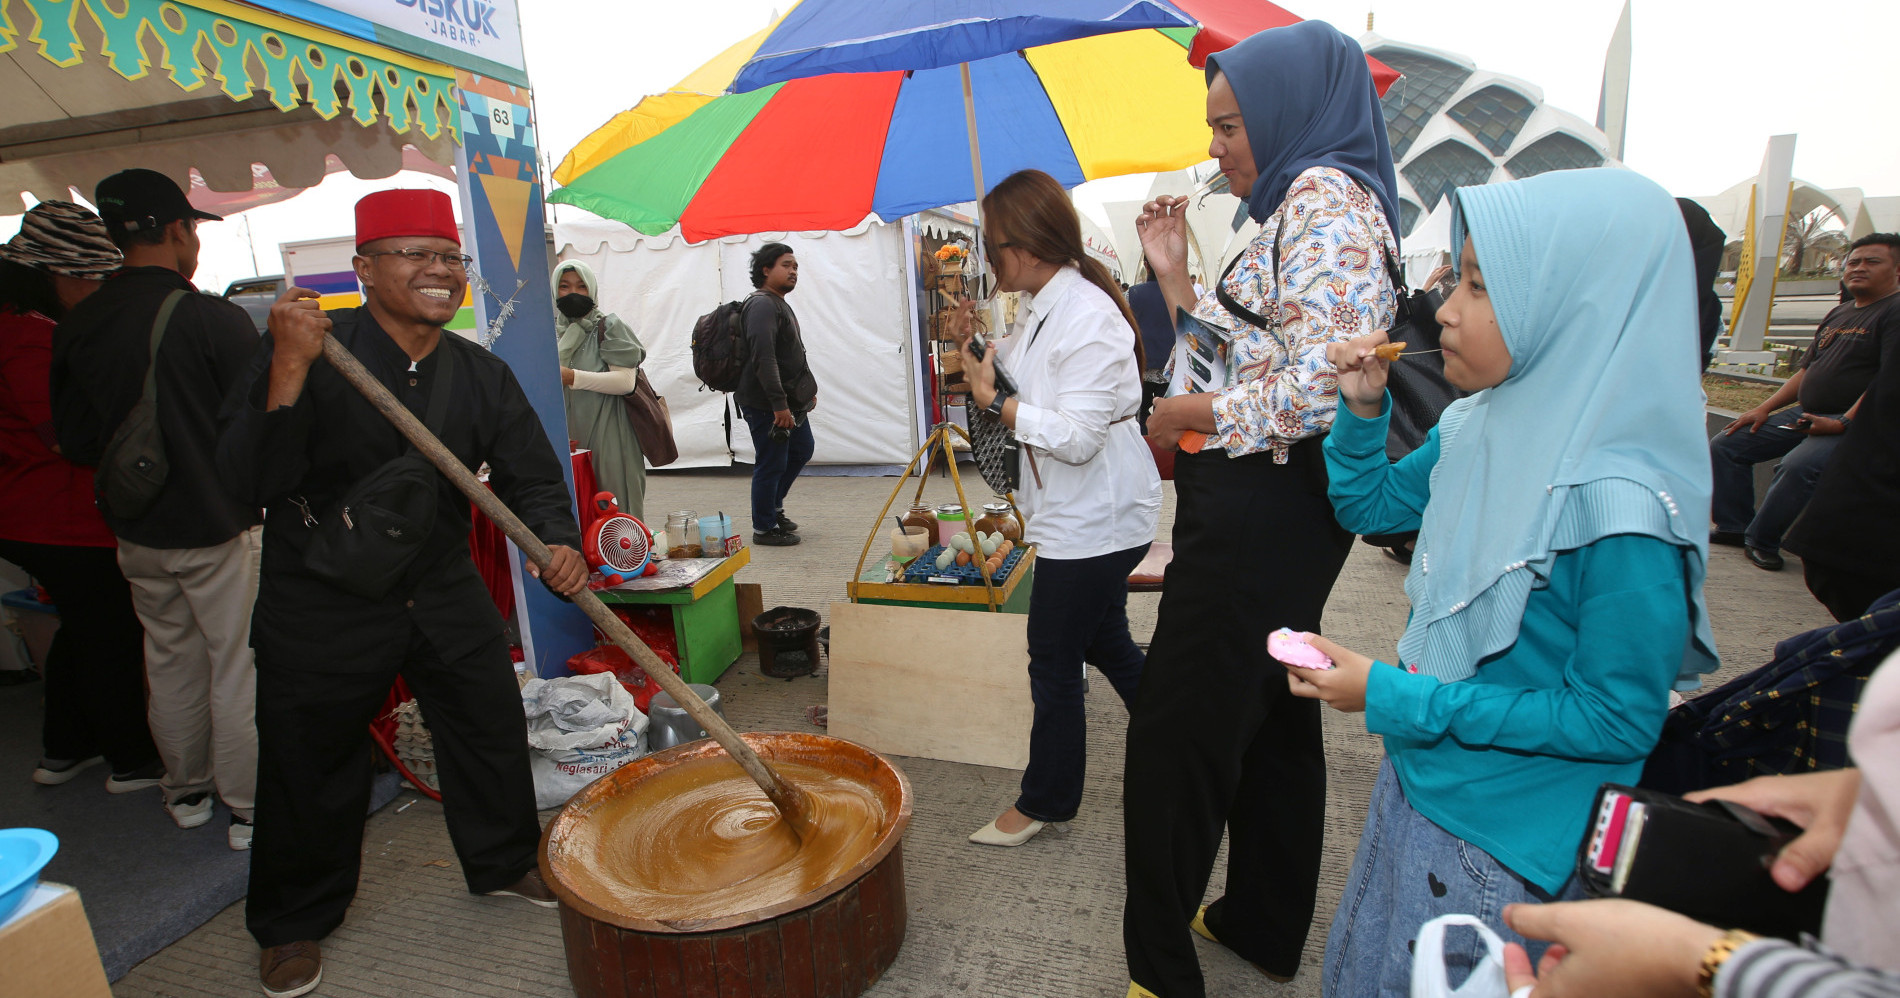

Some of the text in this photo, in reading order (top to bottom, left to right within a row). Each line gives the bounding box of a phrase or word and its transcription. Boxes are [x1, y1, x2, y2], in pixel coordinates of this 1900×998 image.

[396, 0, 500, 40] SKUK
[431, 19, 476, 47] JABAR
[493, 107, 510, 126] 63
[555, 761, 607, 776] Neglasari
